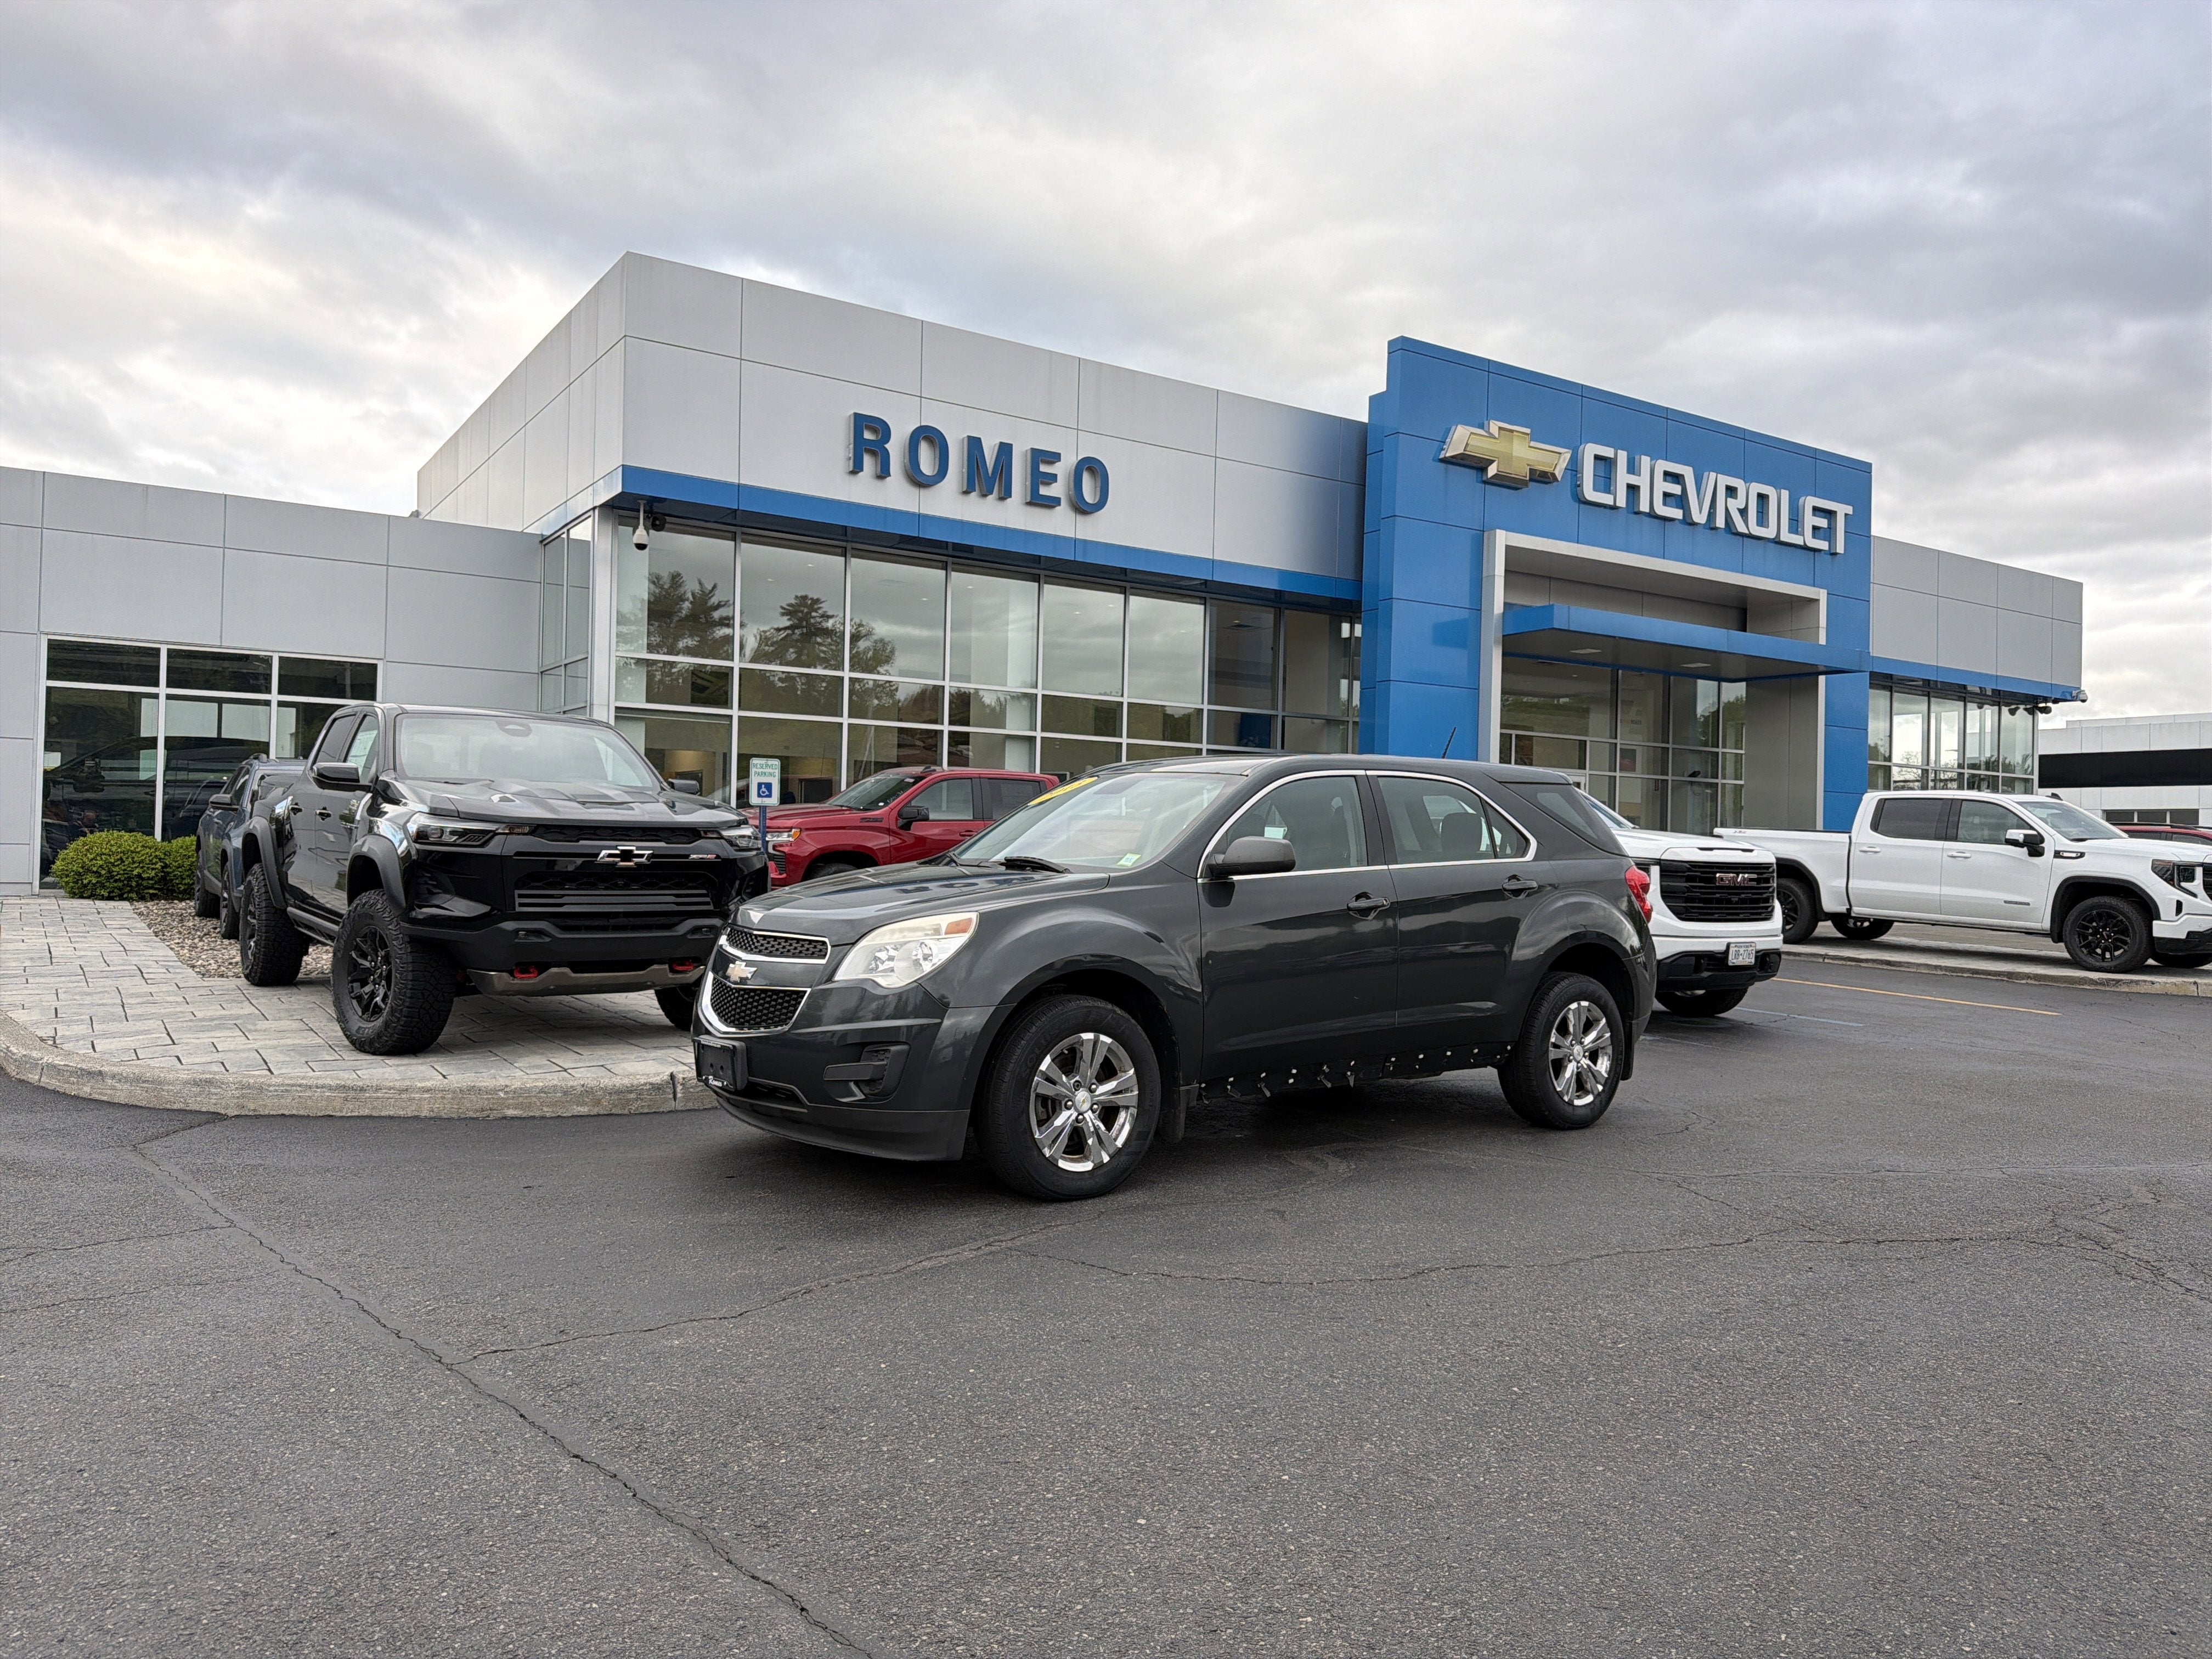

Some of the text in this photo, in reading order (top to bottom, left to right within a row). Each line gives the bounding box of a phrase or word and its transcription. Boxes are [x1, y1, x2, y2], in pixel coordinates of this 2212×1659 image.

[848, 411, 1109, 514] ROMEO
[1577, 442, 1853, 554] CHEVROLET
[1716, 873, 1758, 887] GMC
